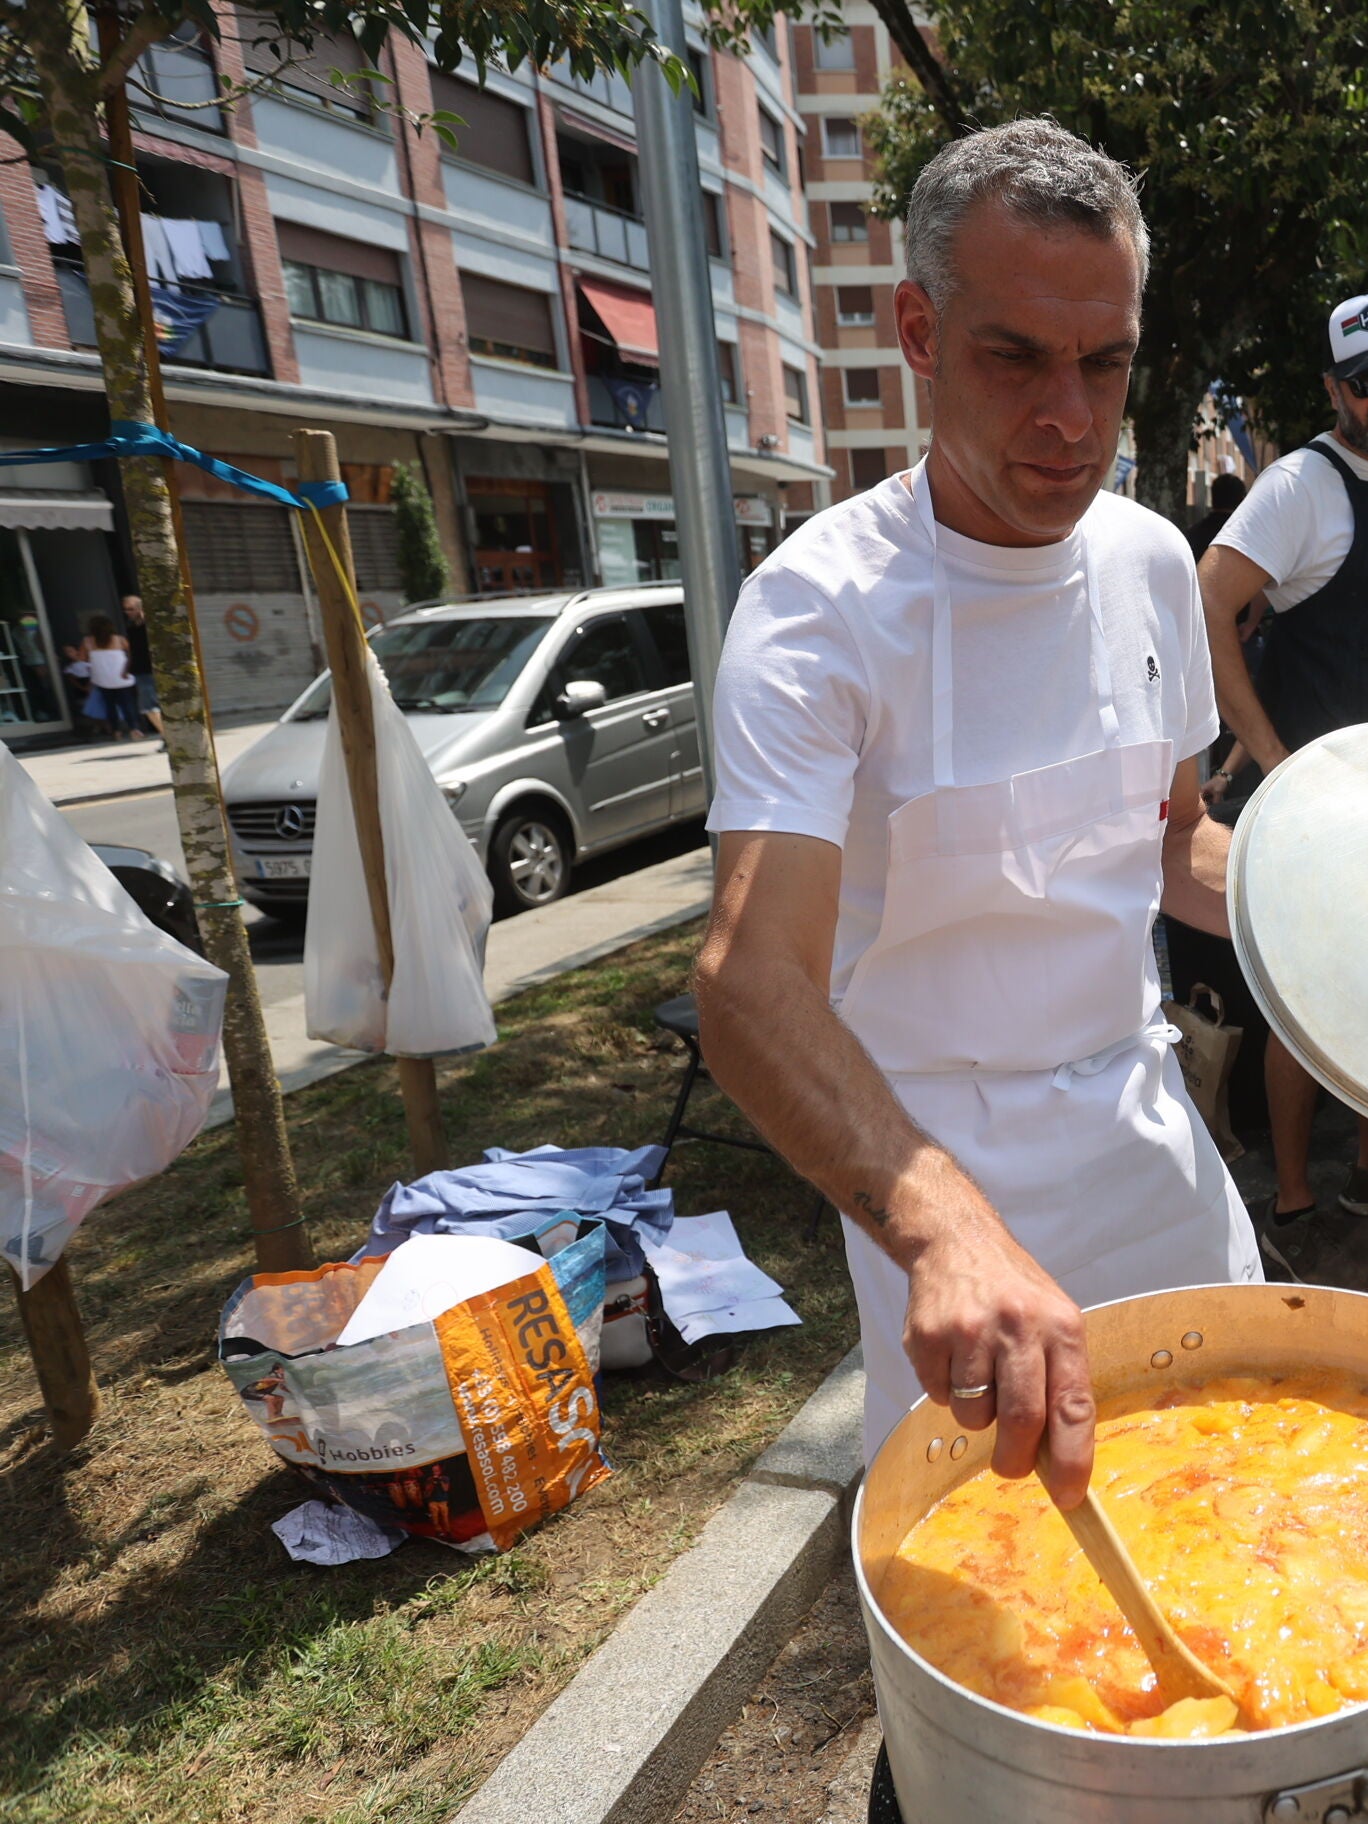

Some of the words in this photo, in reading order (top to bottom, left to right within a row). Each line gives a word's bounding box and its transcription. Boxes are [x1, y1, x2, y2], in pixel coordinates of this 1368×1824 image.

[331, 1442, 416, 1462] Hobbies
[500, 1455, 519, 1482] 482
[507, 1482, 528, 1513] 200
